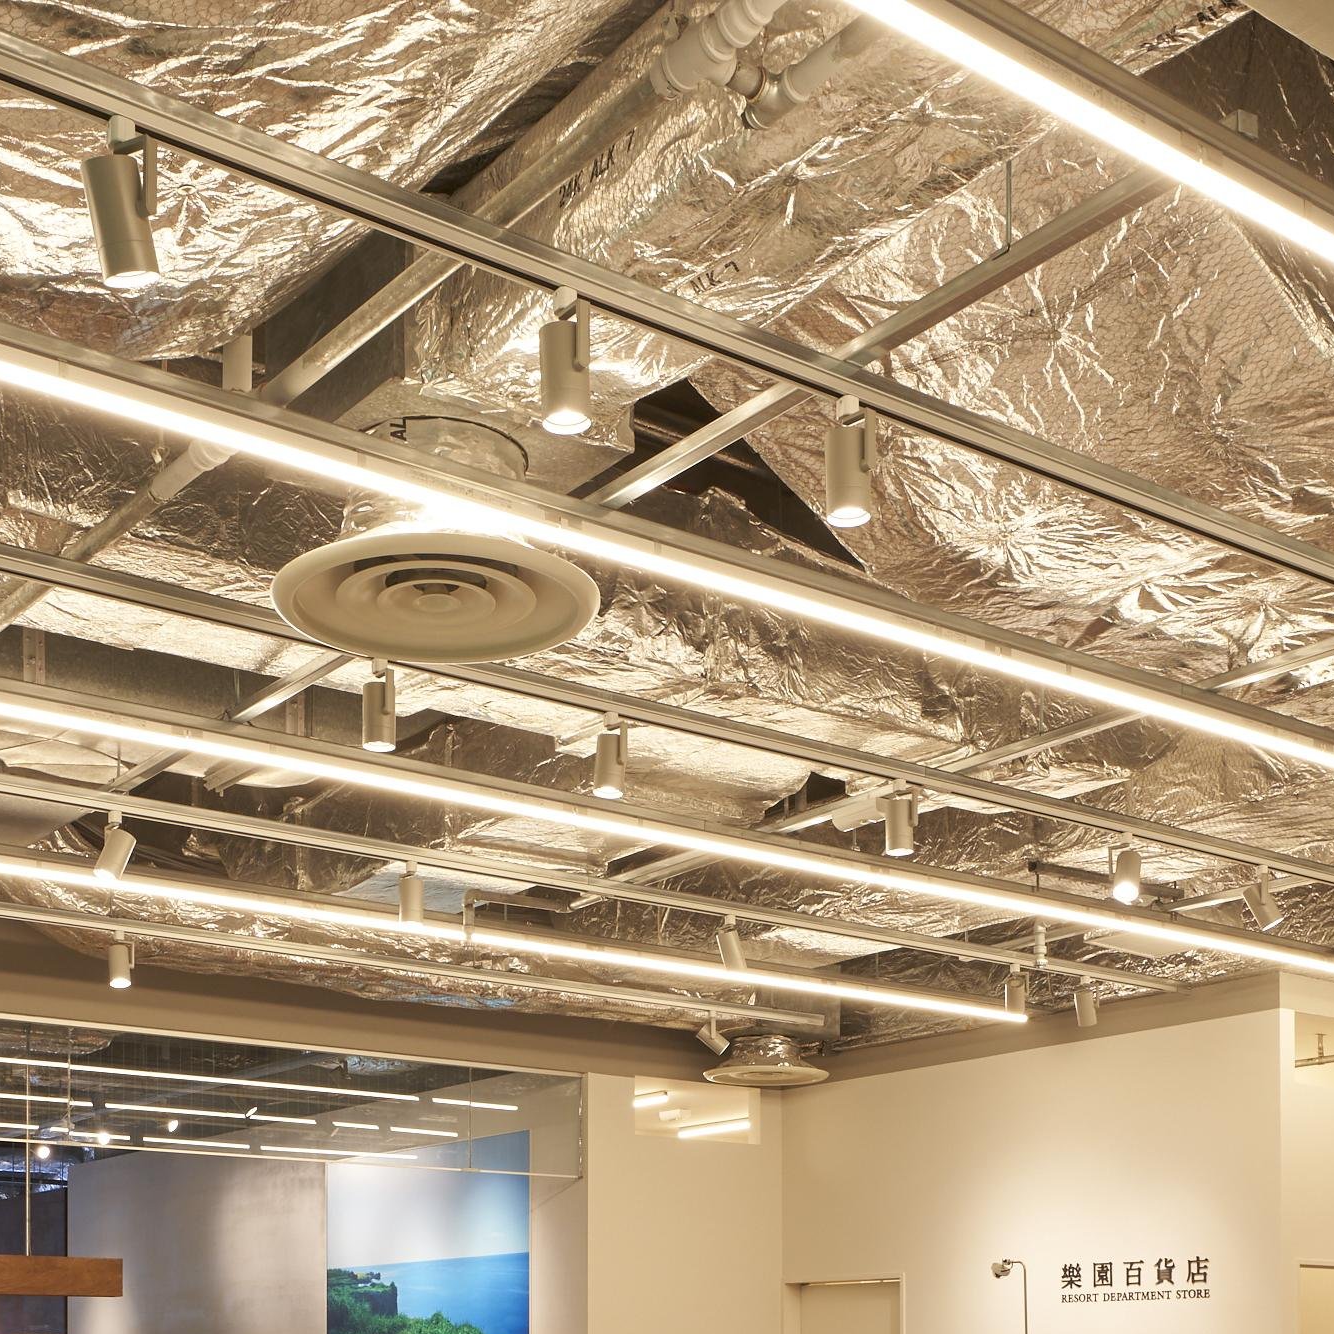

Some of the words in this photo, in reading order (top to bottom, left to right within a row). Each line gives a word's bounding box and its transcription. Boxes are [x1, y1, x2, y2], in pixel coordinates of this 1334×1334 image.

[590, 145, 615, 183] ALK
[1061, 1256, 1211, 1290] 樂園百貨店
[1061, 1292, 1099, 1304] RESORT
[1102, 1290, 1172, 1303] DEPARTMENT
[1175, 1288, 1211, 1301] STORE
